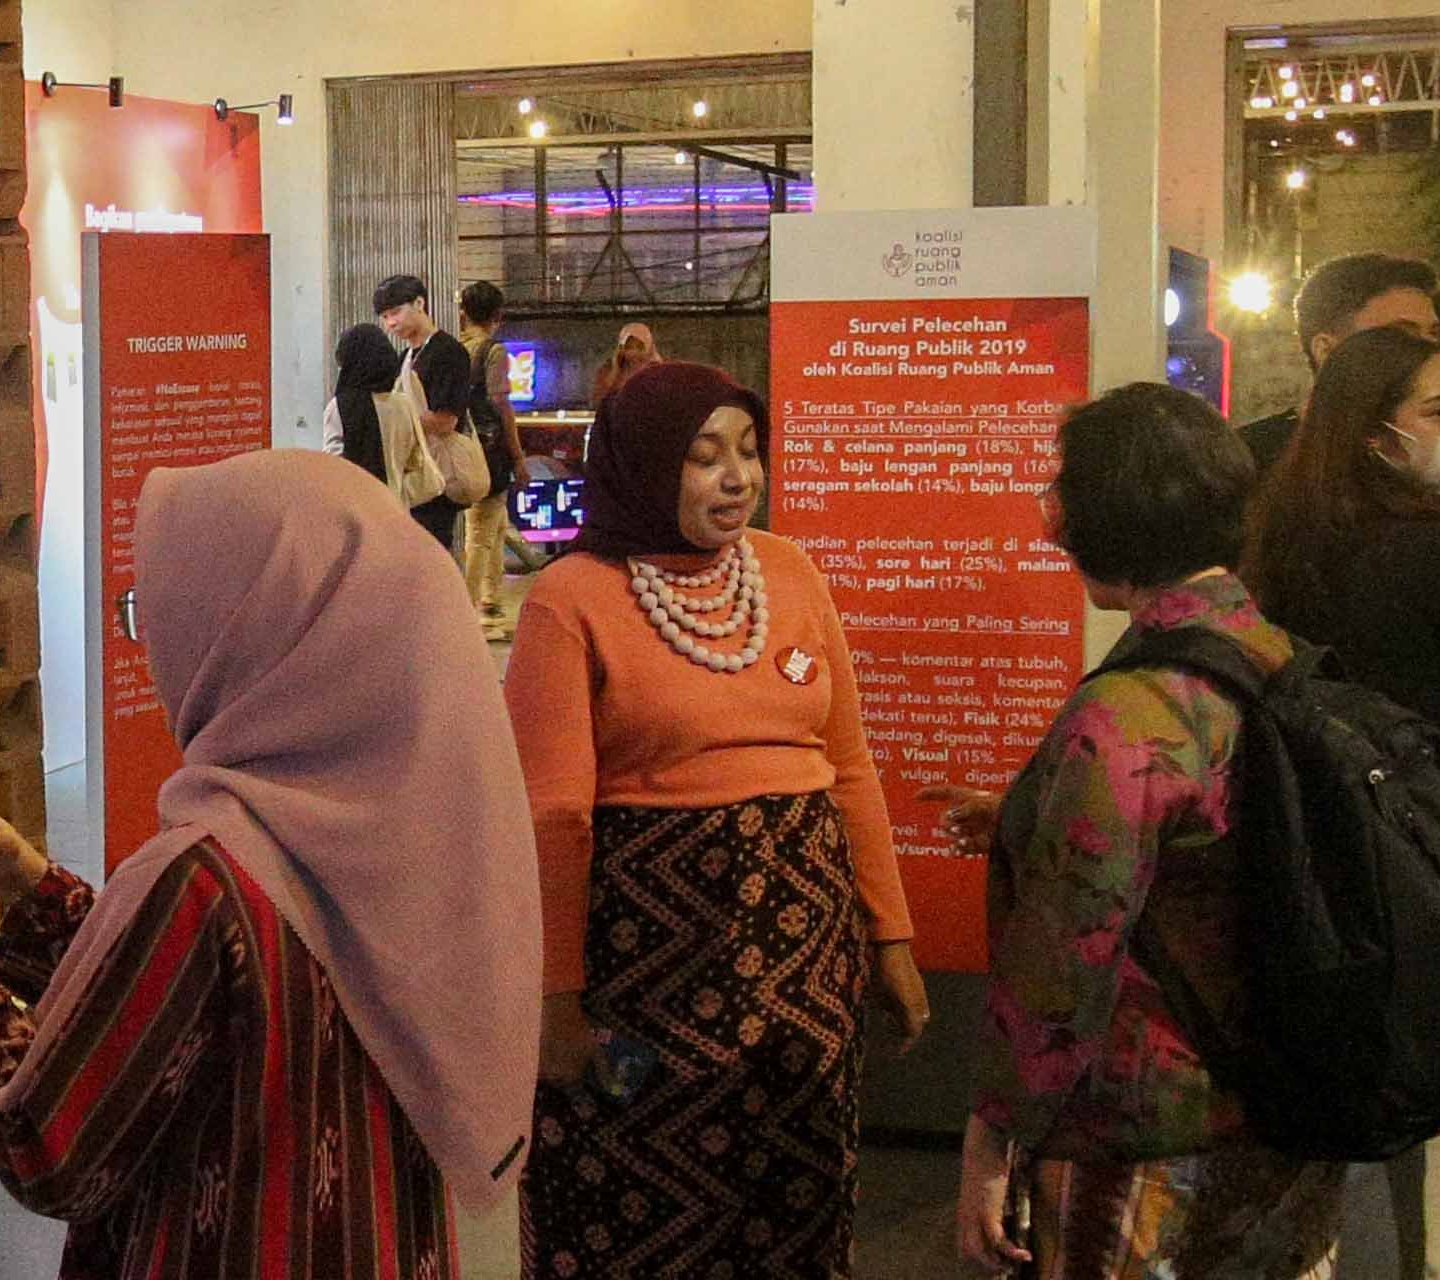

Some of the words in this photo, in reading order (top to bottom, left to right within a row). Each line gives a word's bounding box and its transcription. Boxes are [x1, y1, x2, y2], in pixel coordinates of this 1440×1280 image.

[915, 231, 963, 243] koalisi
[915, 246, 961, 259] ruang
[915, 260, 961, 273] publik
[915, 275, 957, 287] aman
[849, 318, 906, 333] Survei
[913, 317, 1006, 333] Pelecehan
[127, 336, 183, 353] TRIGGER
[186, 333, 247, 351] WARNING
[829, 342, 846, 356] di
[853, 342, 910, 359] Ruang
[917, 340, 973, 355] Publik
[980, 340, 1026, 355] 2019
[803, 363, 836, 376] oleh
[841, 363, 892, 376] Koalisi
[898, 362, 947, 378] Ruang
[953, 362, 1002, 375] Publik
[1009, 362, 1054, 374] Aman
[784, 402, 793, 415] 5
[802, 401, 854, 415] Teratas
[863, 401, 895, 417] Tipe
[904, 400, 962, 414] Pakaian
[970, 403, 1007, 418] yang
[784, 421, 850, 434] Gunakan
[854, 421, 883, 434] saat
[890, 421, 973, 437] Mengalami
[784, 440, 814, 453] Rok
[823, 441, 835, 453] &
[845, 441, 894, 453] celana
[904, 441, 967, 457] panjang
[784, 480, 849, 493] seragam
[854, 479, 913, 492] sekolah
[970, 479, 1003, 493] baju
